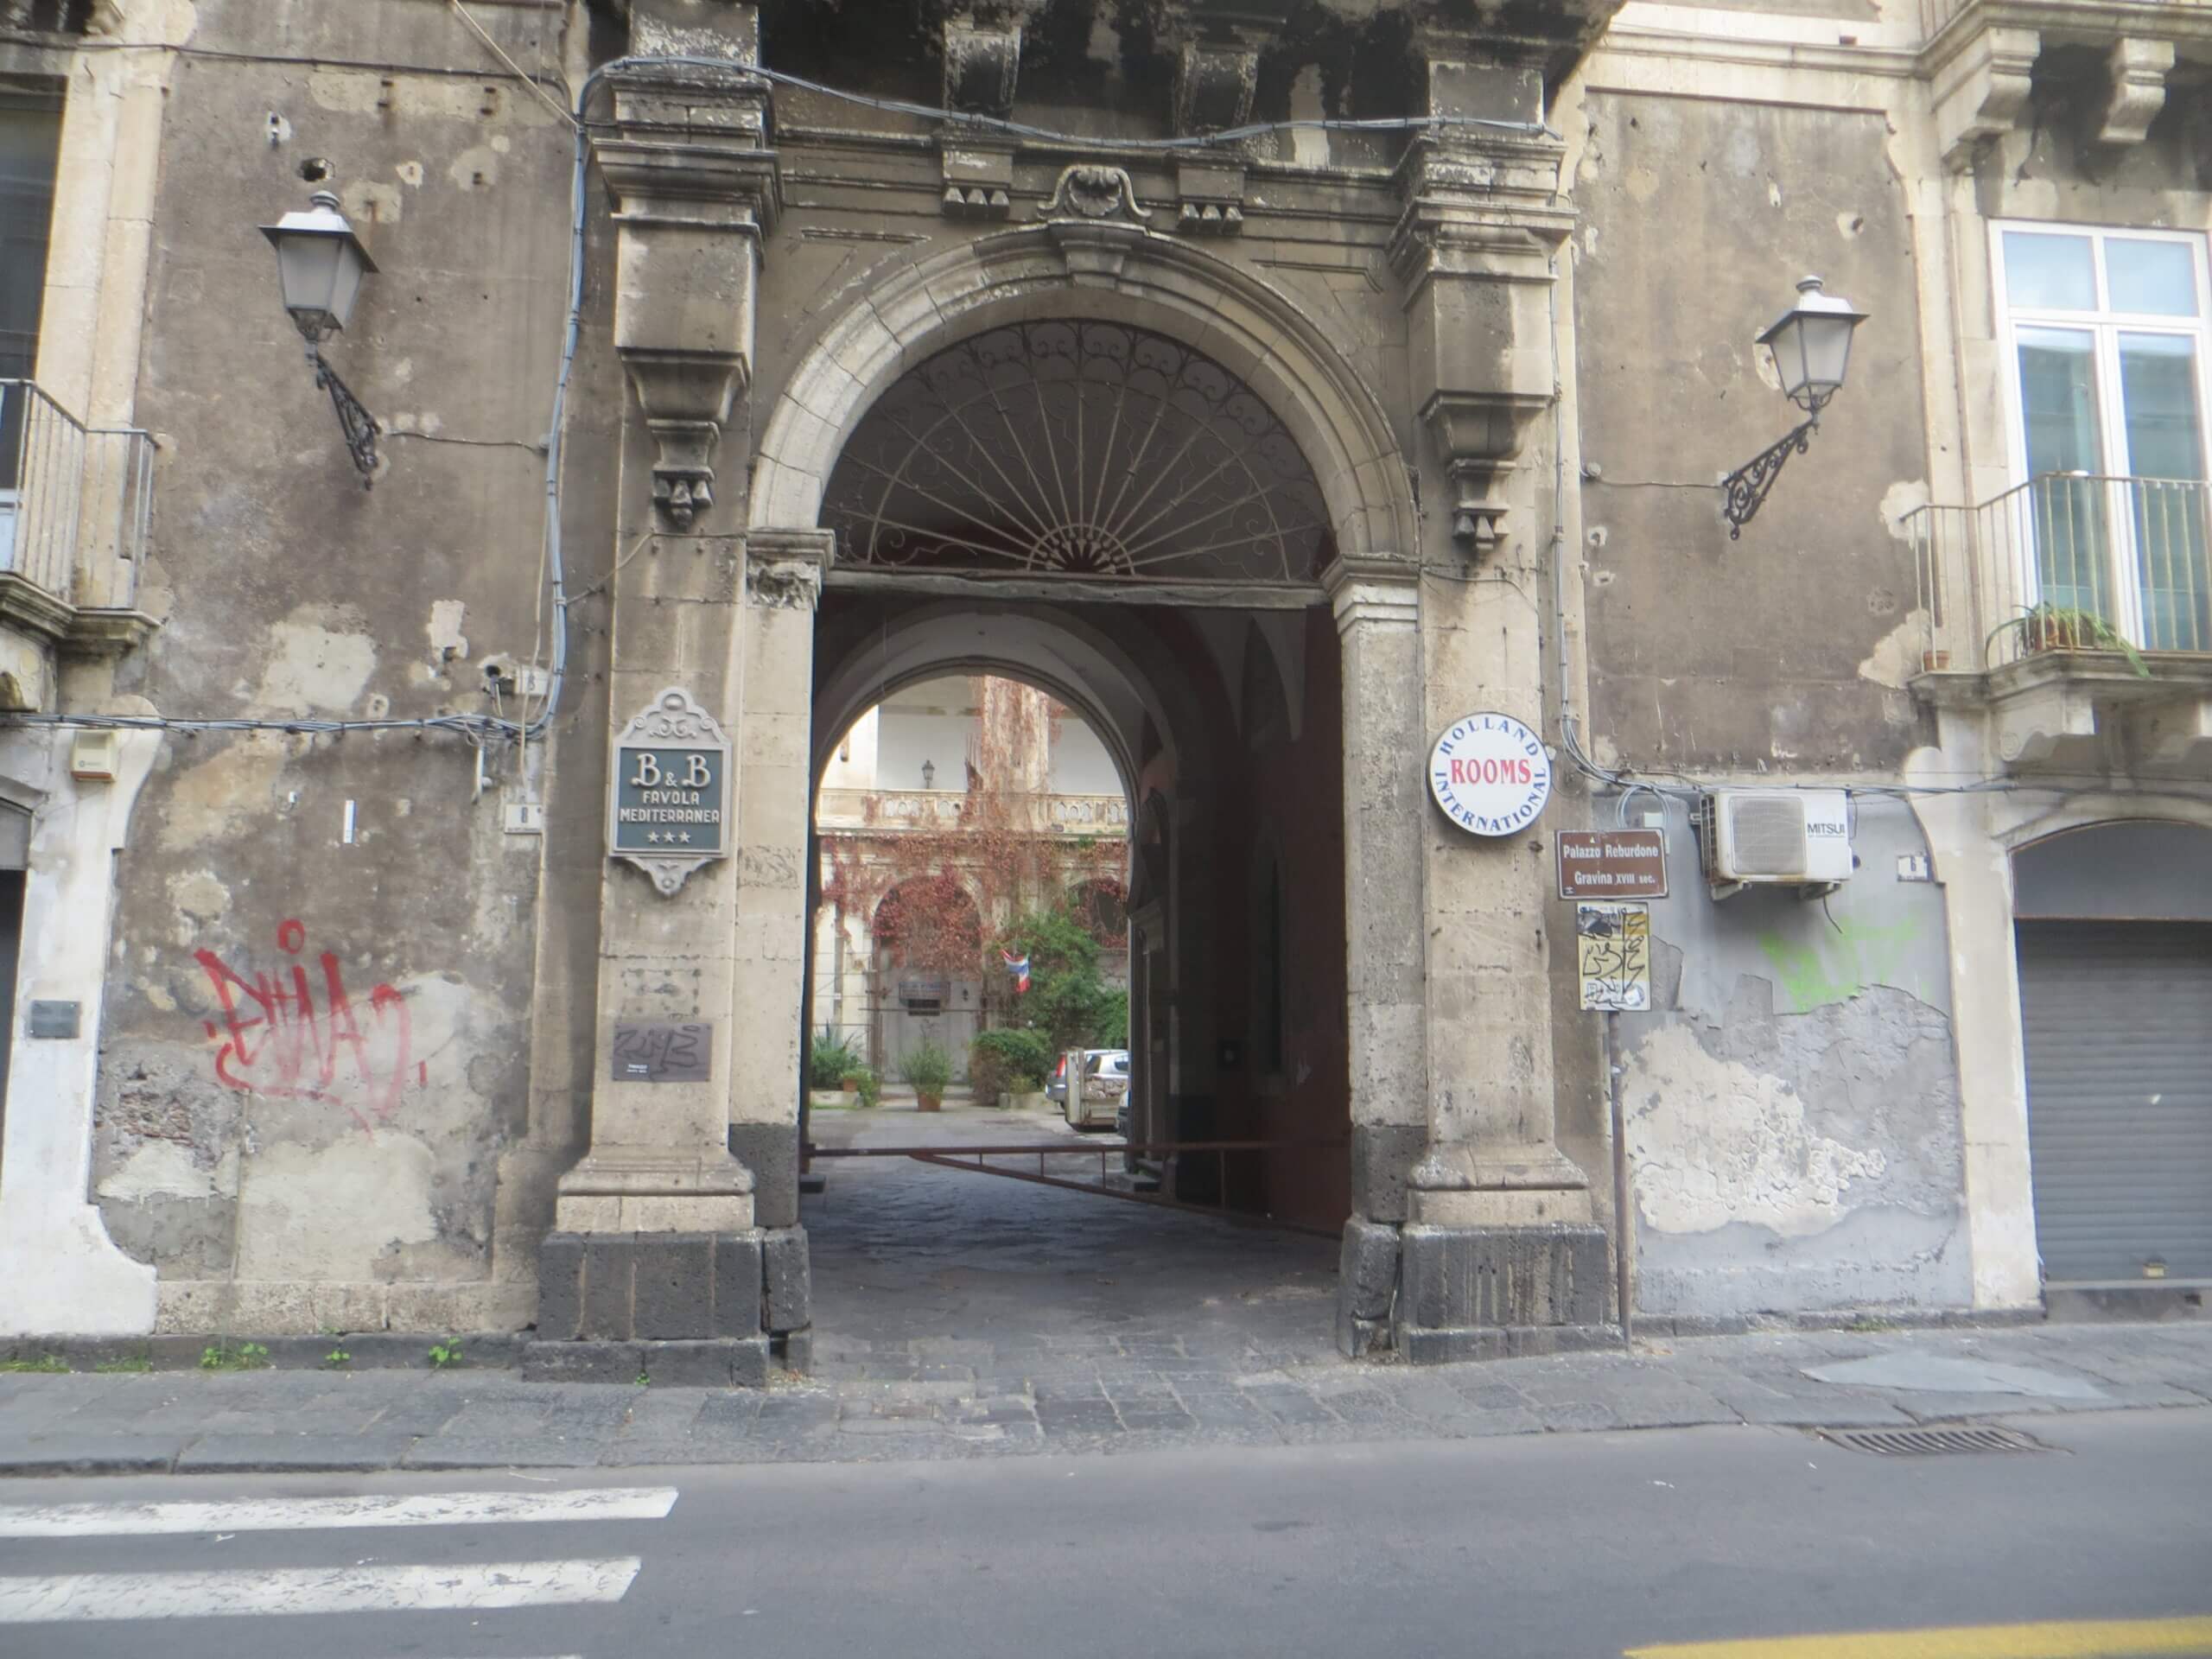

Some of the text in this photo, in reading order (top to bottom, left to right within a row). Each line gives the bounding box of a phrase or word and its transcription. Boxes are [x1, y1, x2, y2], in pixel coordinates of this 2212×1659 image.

[1440, 716, 1539, 756] HOLLAND
[631, 753, 711, 788] B & B
[1450, 759, 1532, 785] ROOMS
[642, 791, 700, 805] FAVOLA
[1435, 768, 1547, 831] INTERNATIONAL
[620, 808, 720, 823] MEDITERRANEA
[1807, 823, 1846, 835] MITSUI
[1563, 843, 1659, 858] Palazzo Reburdone
[1574, 871, 1612, 885] Gravina
[1616, 873, 1635, 884] XVIII
